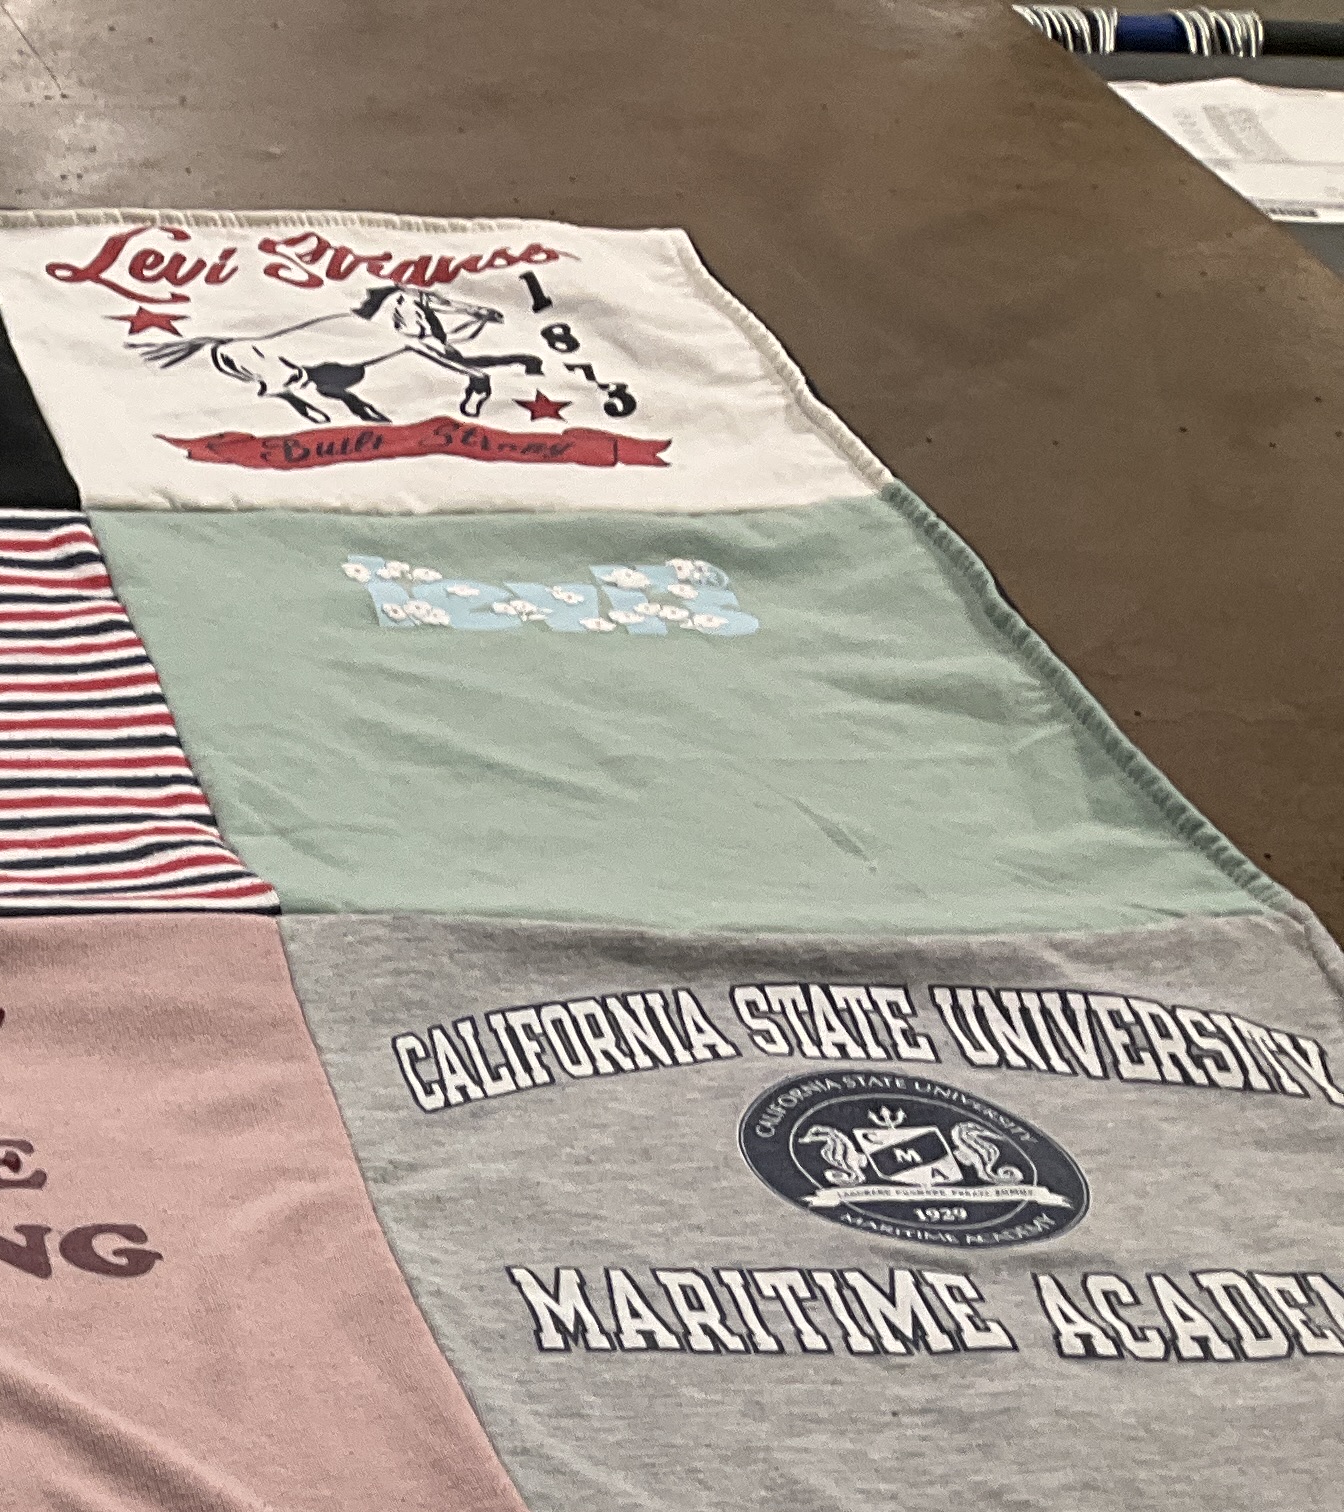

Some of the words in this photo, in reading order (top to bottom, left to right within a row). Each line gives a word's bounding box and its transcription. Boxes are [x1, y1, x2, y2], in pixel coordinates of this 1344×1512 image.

[45, 225, 240, 304] Levi
[256, 230, 582, 289] Strauss
[391, 986, 745, 1115] CALIFORNIA
[729, 981, 943, 1064] STATE
[927, 984, 1344, 1108] UNIVERSITY
[754, 1074, 842, 1138] CALIFORNIA
[841, 1073, 908, 1093] STATE
[505, 1265, 1020, 1355] MARITIME
